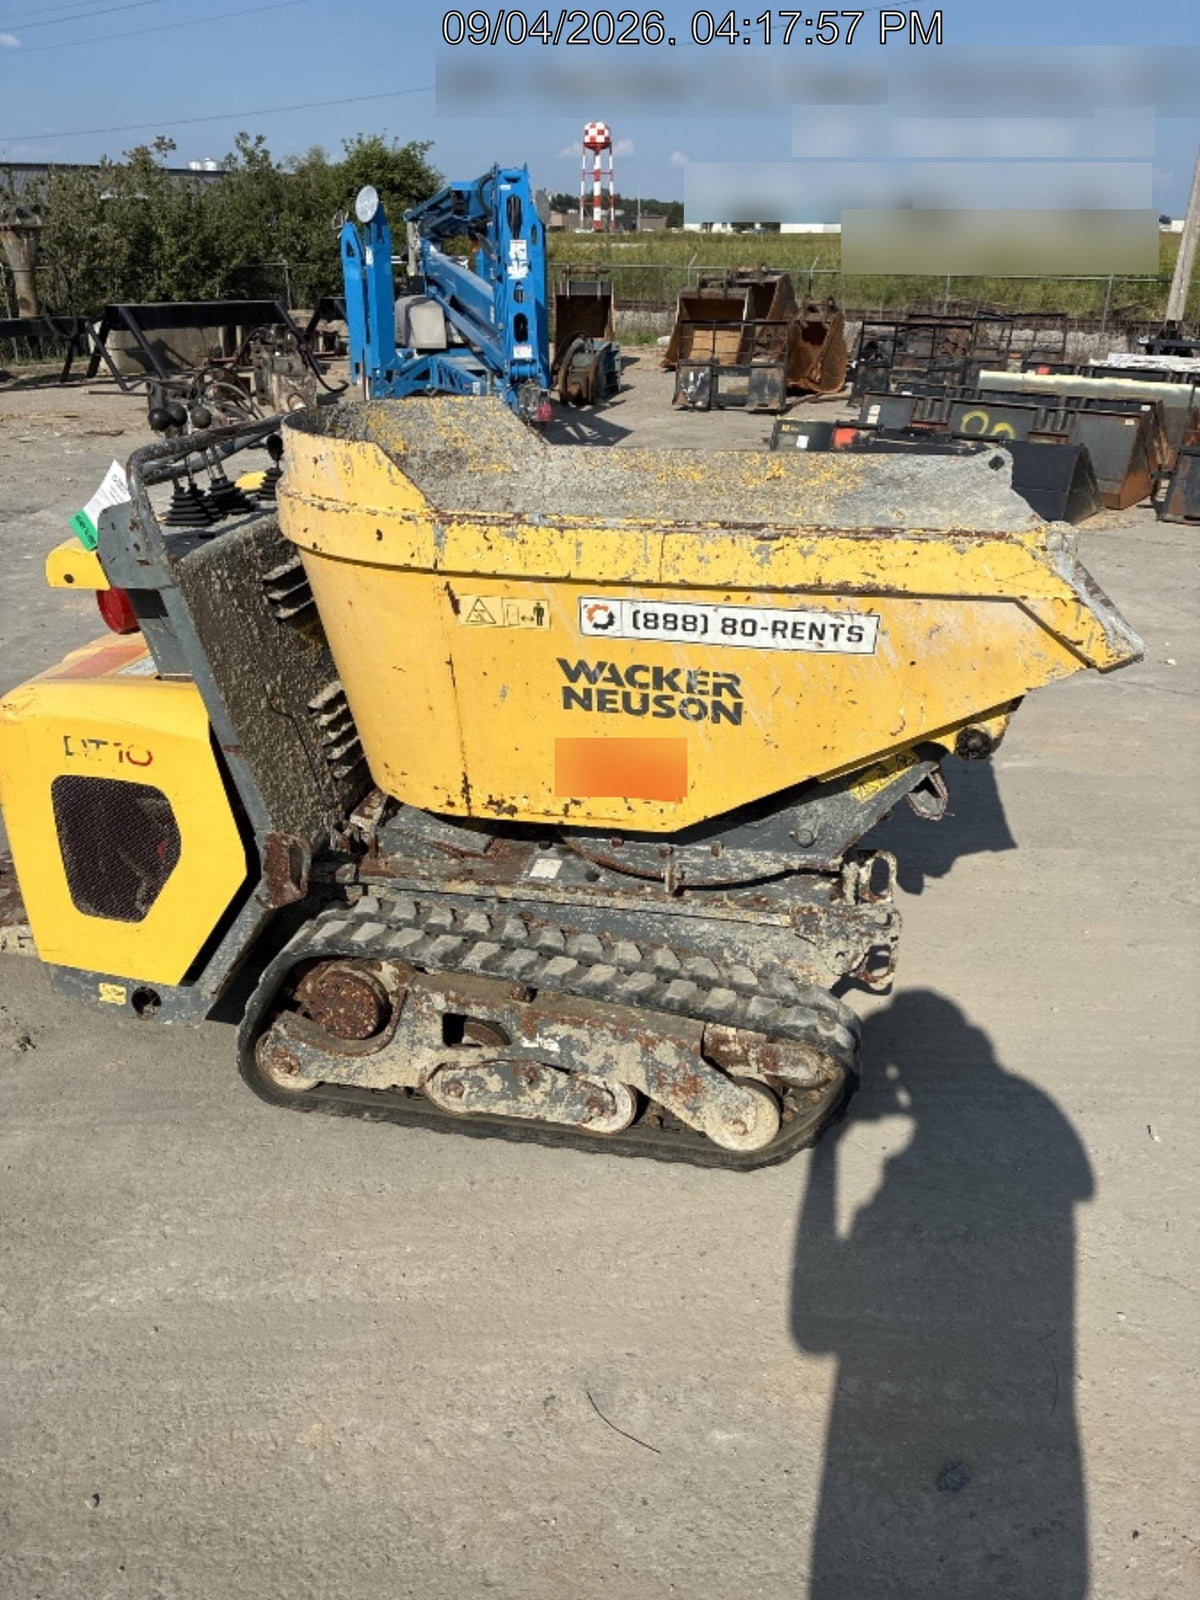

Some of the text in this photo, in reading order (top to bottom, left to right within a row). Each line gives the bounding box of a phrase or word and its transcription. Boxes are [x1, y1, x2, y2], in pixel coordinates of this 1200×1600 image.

[632, 610, 864, 643] (888) 80-RENTS
[556, 657, 744, 699] WACKER
[562, 685, 744, 726] NEUSON
